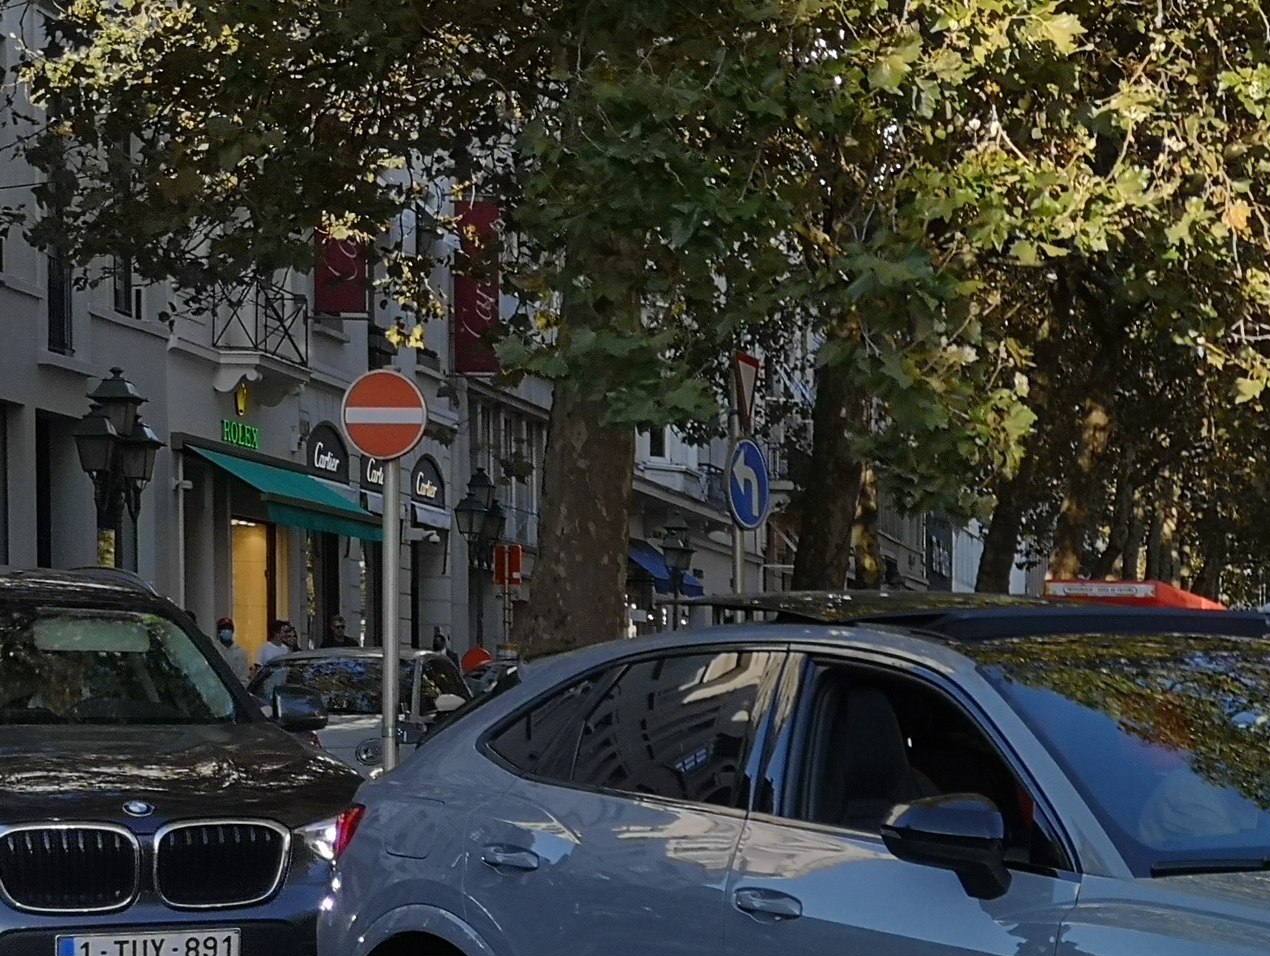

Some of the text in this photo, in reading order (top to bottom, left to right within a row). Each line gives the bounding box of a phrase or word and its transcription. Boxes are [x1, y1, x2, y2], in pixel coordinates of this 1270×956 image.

[222, 420, 259, 449] ROLEX
[314, 441, 340, 472] Cartier
[416, 471, 438, 499] Cartier
